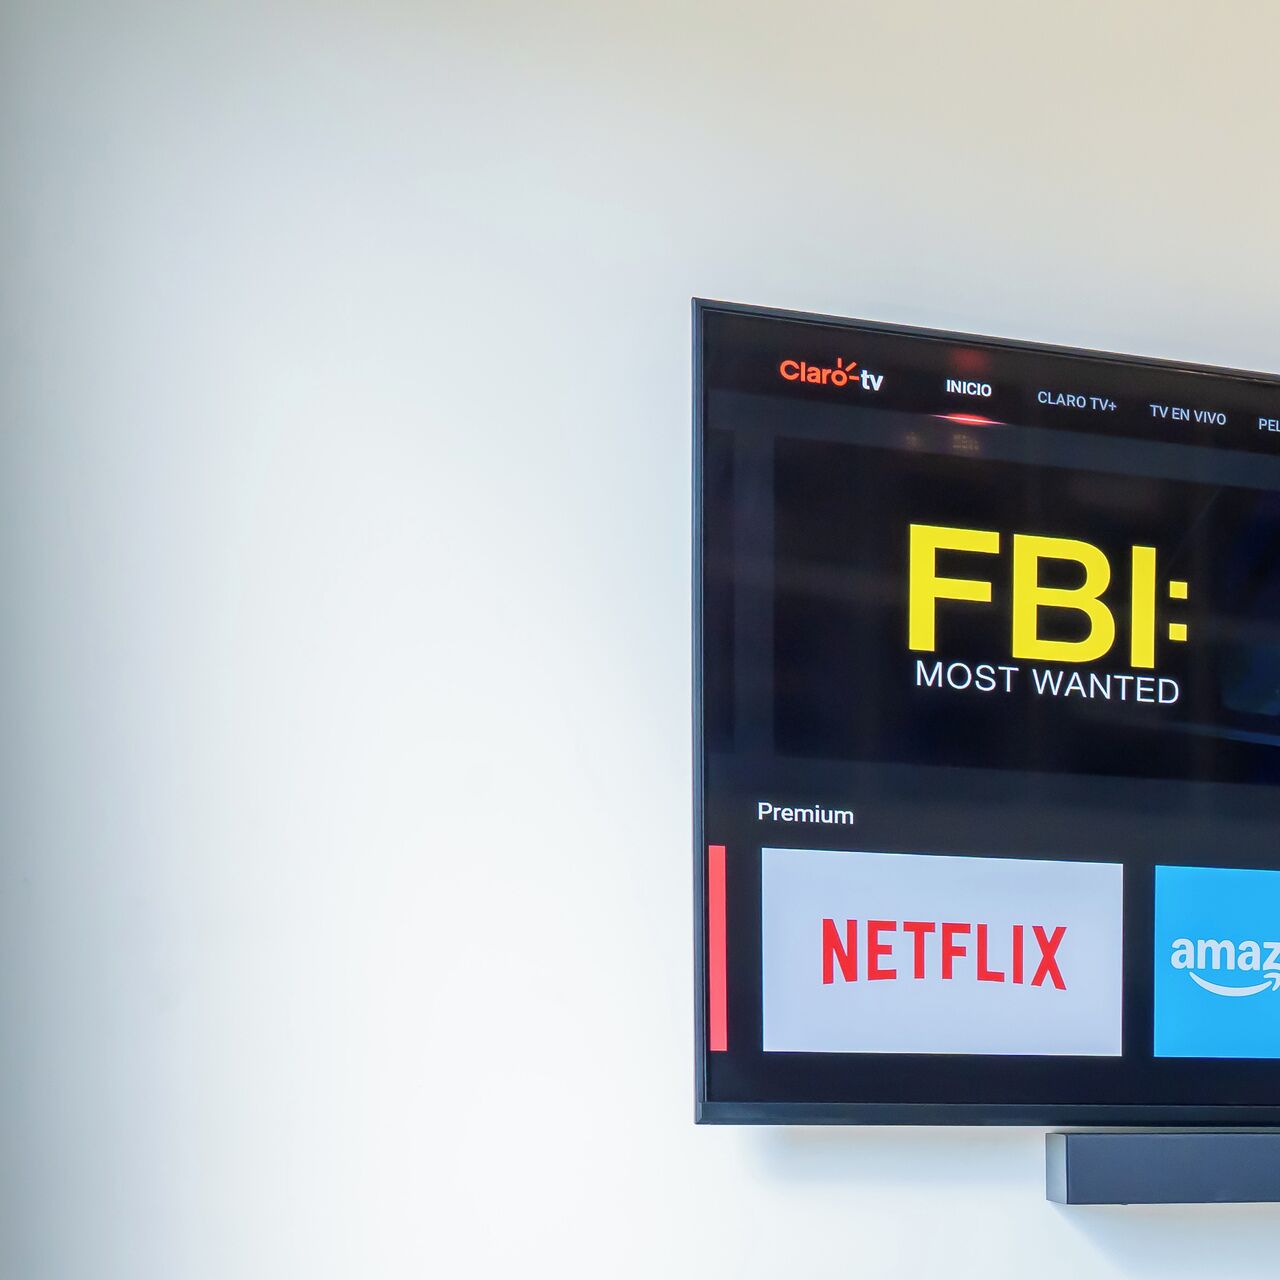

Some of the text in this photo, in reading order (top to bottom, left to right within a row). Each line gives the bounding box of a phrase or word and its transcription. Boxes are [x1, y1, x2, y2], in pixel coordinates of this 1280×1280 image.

[779, 359, 884, 392] Claro tv
[946, 379, 992, 397] INICIO
[1037, 391, 1117, 411] CLARO TV+
[1149, 404, 1227, 426] TV EN VIVO
[908, 524, 1188, 668] FBI:
[915, 660, 1180, 705] MOST WANTED
[758, 801, 855, 825] Premium
[823, 918, 1067, 991] NETFLIX
